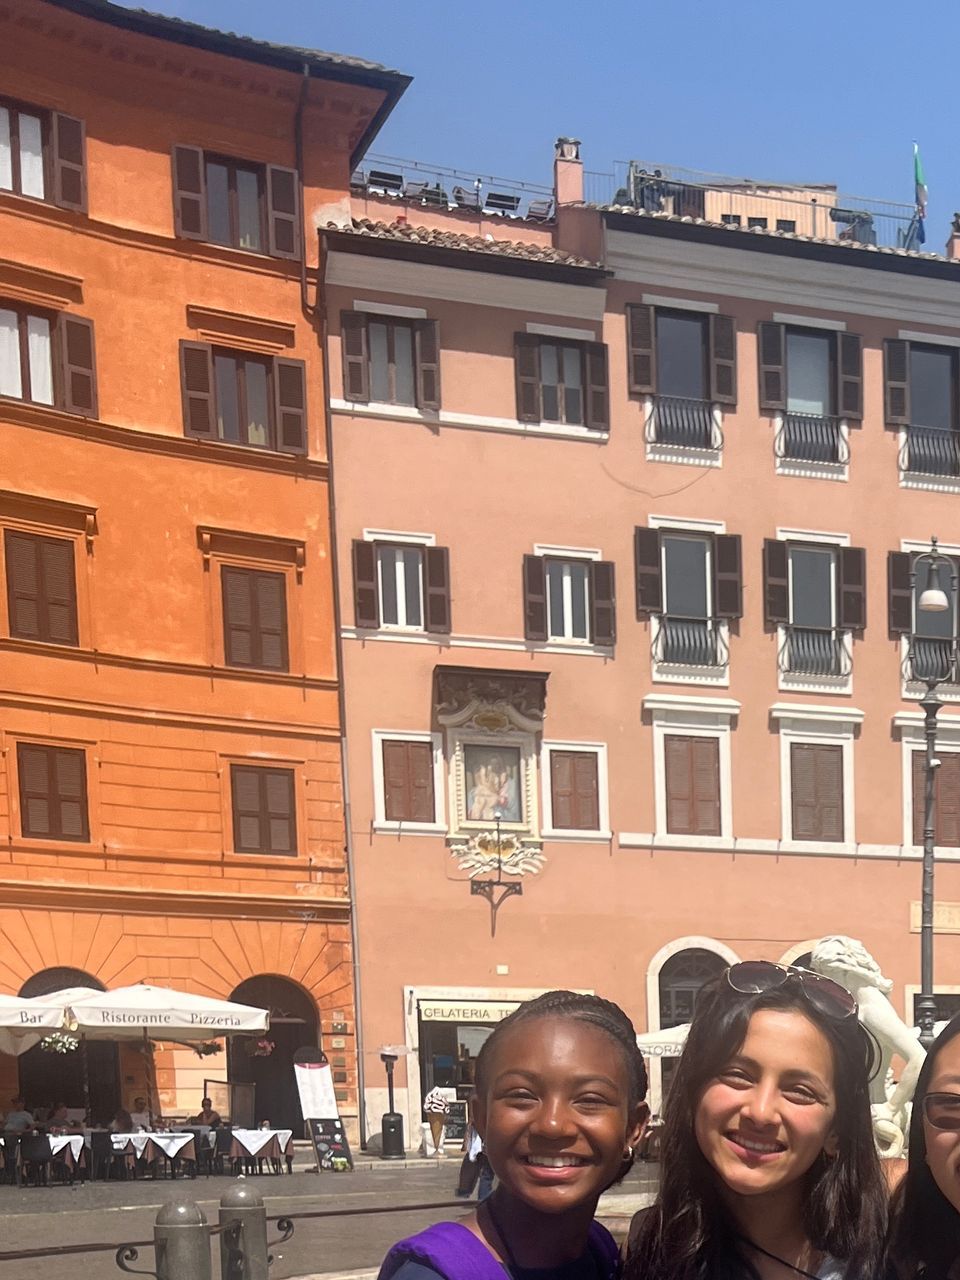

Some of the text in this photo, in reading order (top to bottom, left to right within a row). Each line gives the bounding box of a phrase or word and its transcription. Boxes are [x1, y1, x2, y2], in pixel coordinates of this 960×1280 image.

[20, 1011, 43, 1024] Bar
[101, 1011, 241, 1026] Ristorante Pizzeria
[424, 1008, 490, 1018] GELATERIA
